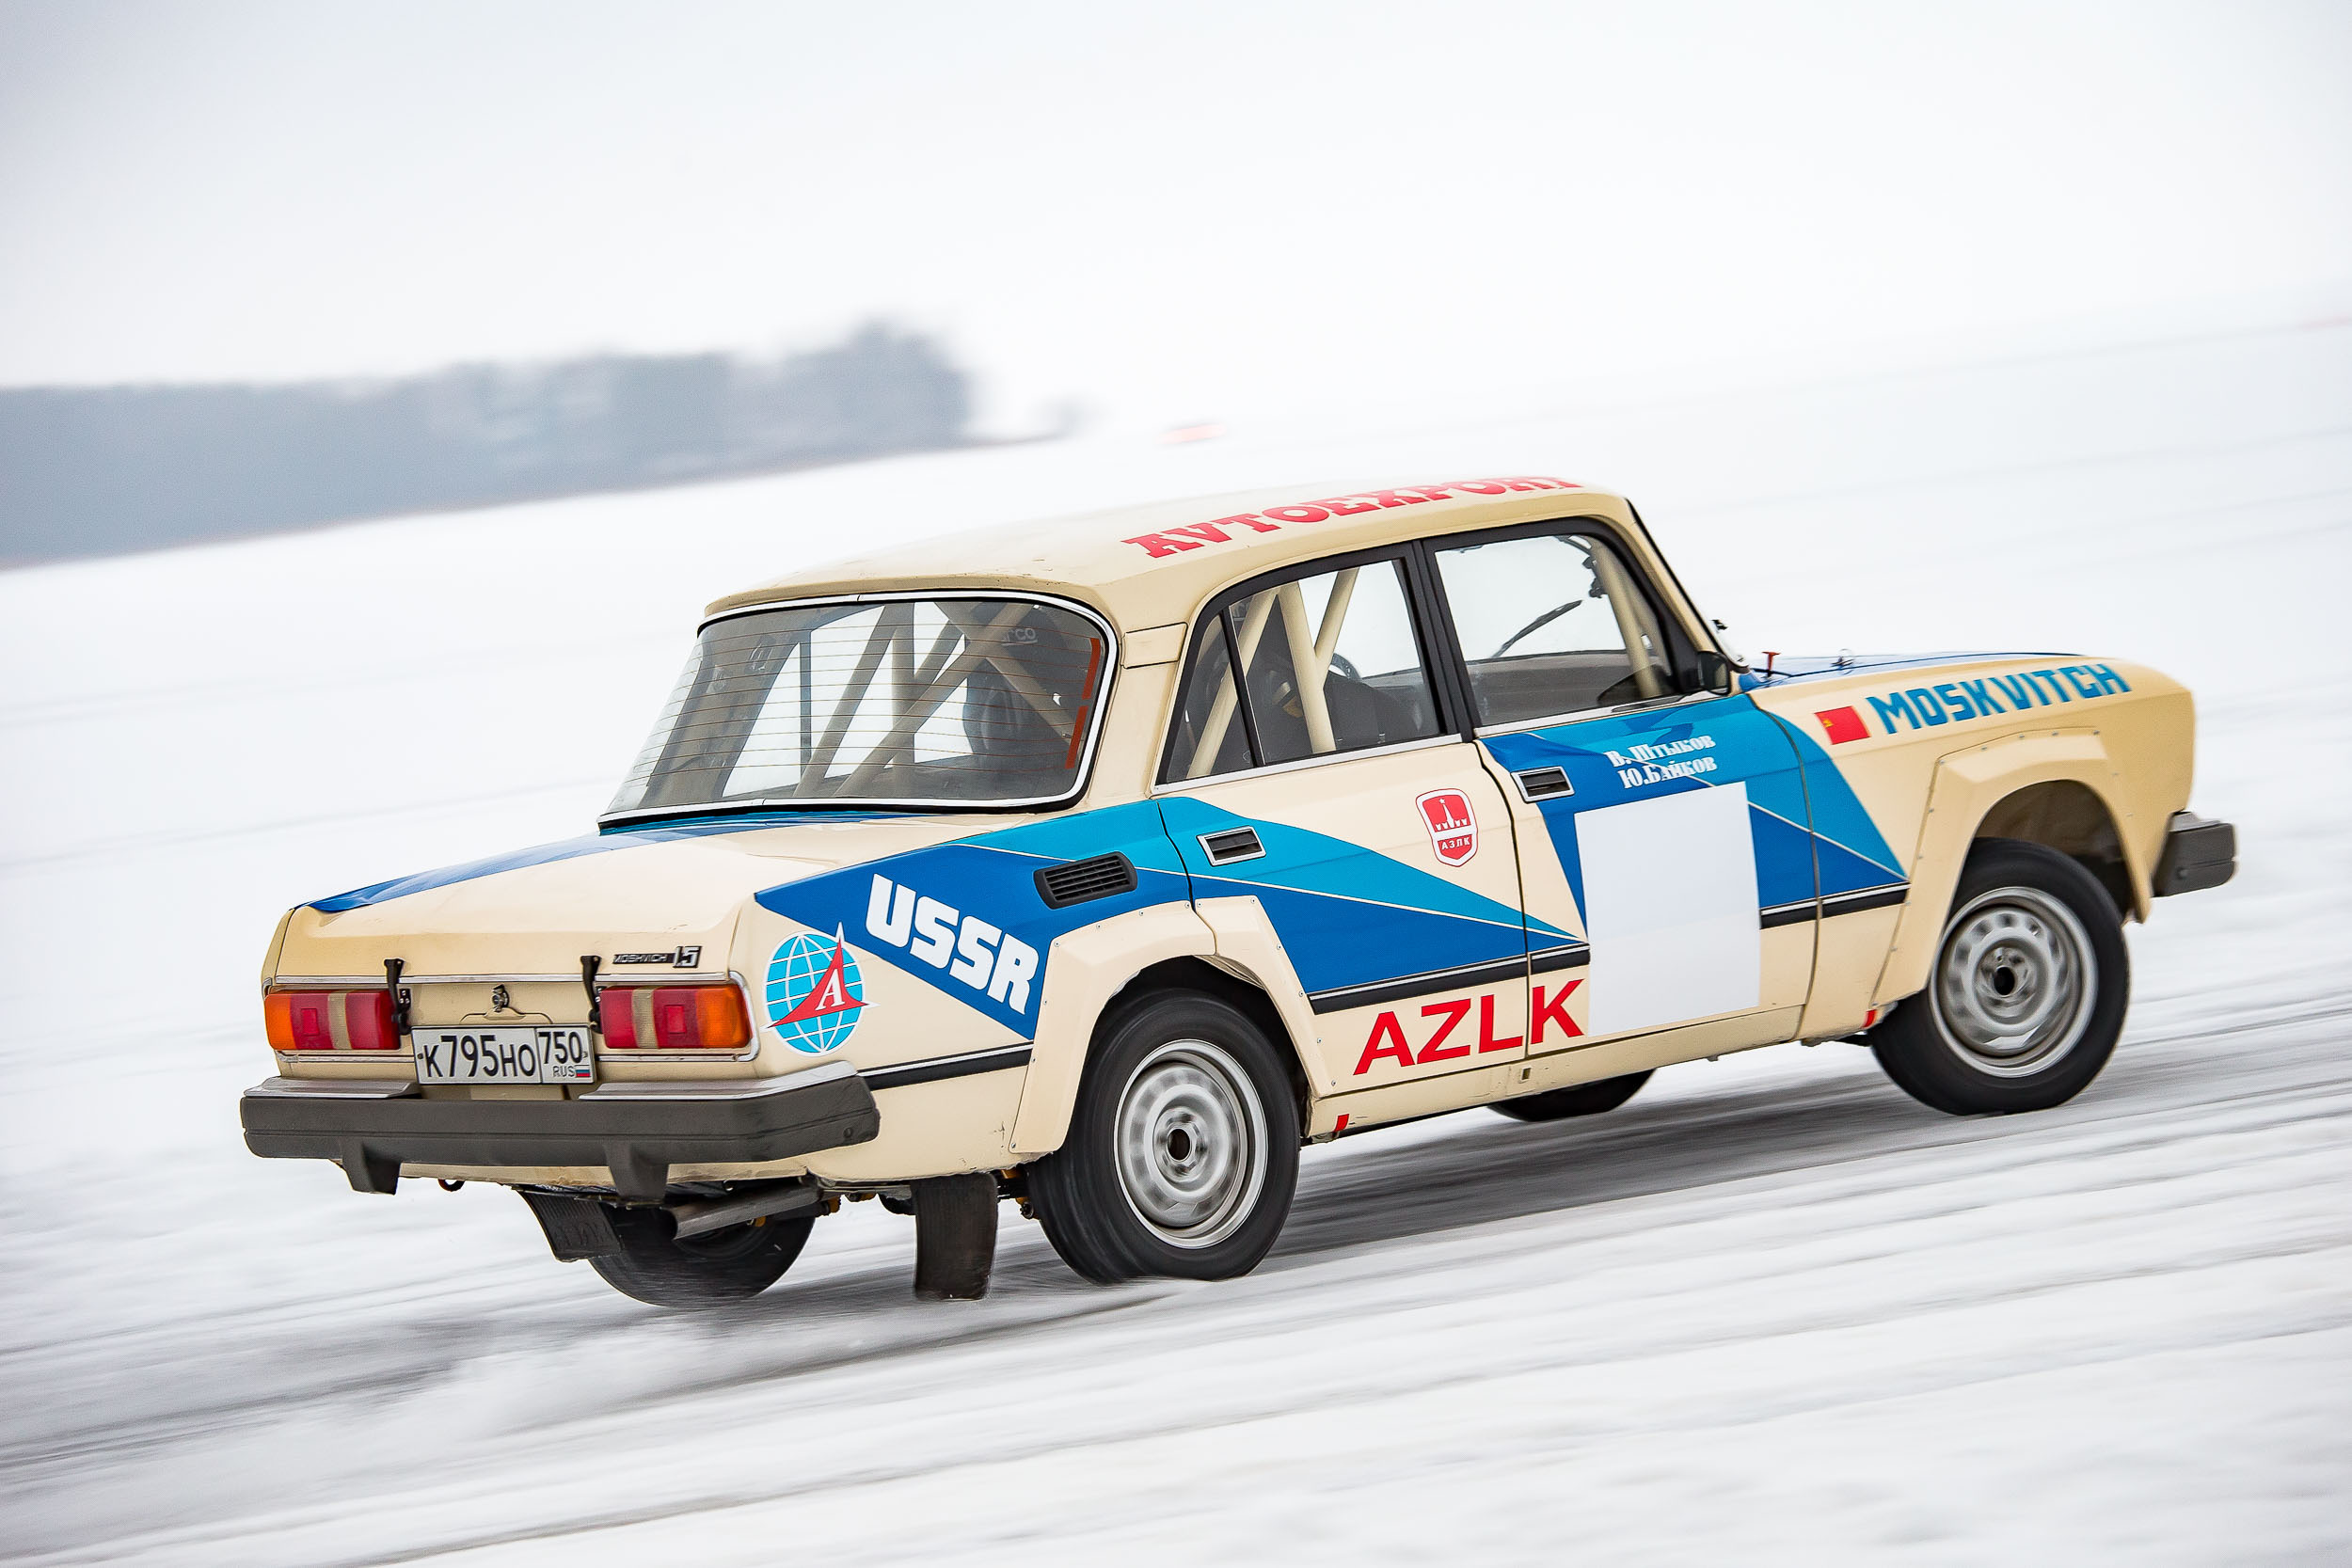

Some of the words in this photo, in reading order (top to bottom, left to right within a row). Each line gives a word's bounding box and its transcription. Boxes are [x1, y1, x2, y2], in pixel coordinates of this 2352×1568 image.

[1120, 476, 1581, 558] AVTOEXPORT
[1865, 663, 2132, 735] MOSKVITCH
[1441, 836, 1470, 850] АЗЛК
[866, 873, 1040, 1016] USSR
[538, 1031, 583, 1065] 750
[1353, 978, 1586, 1075] AZLK
[552, 1065, 576, 1078] RUS
